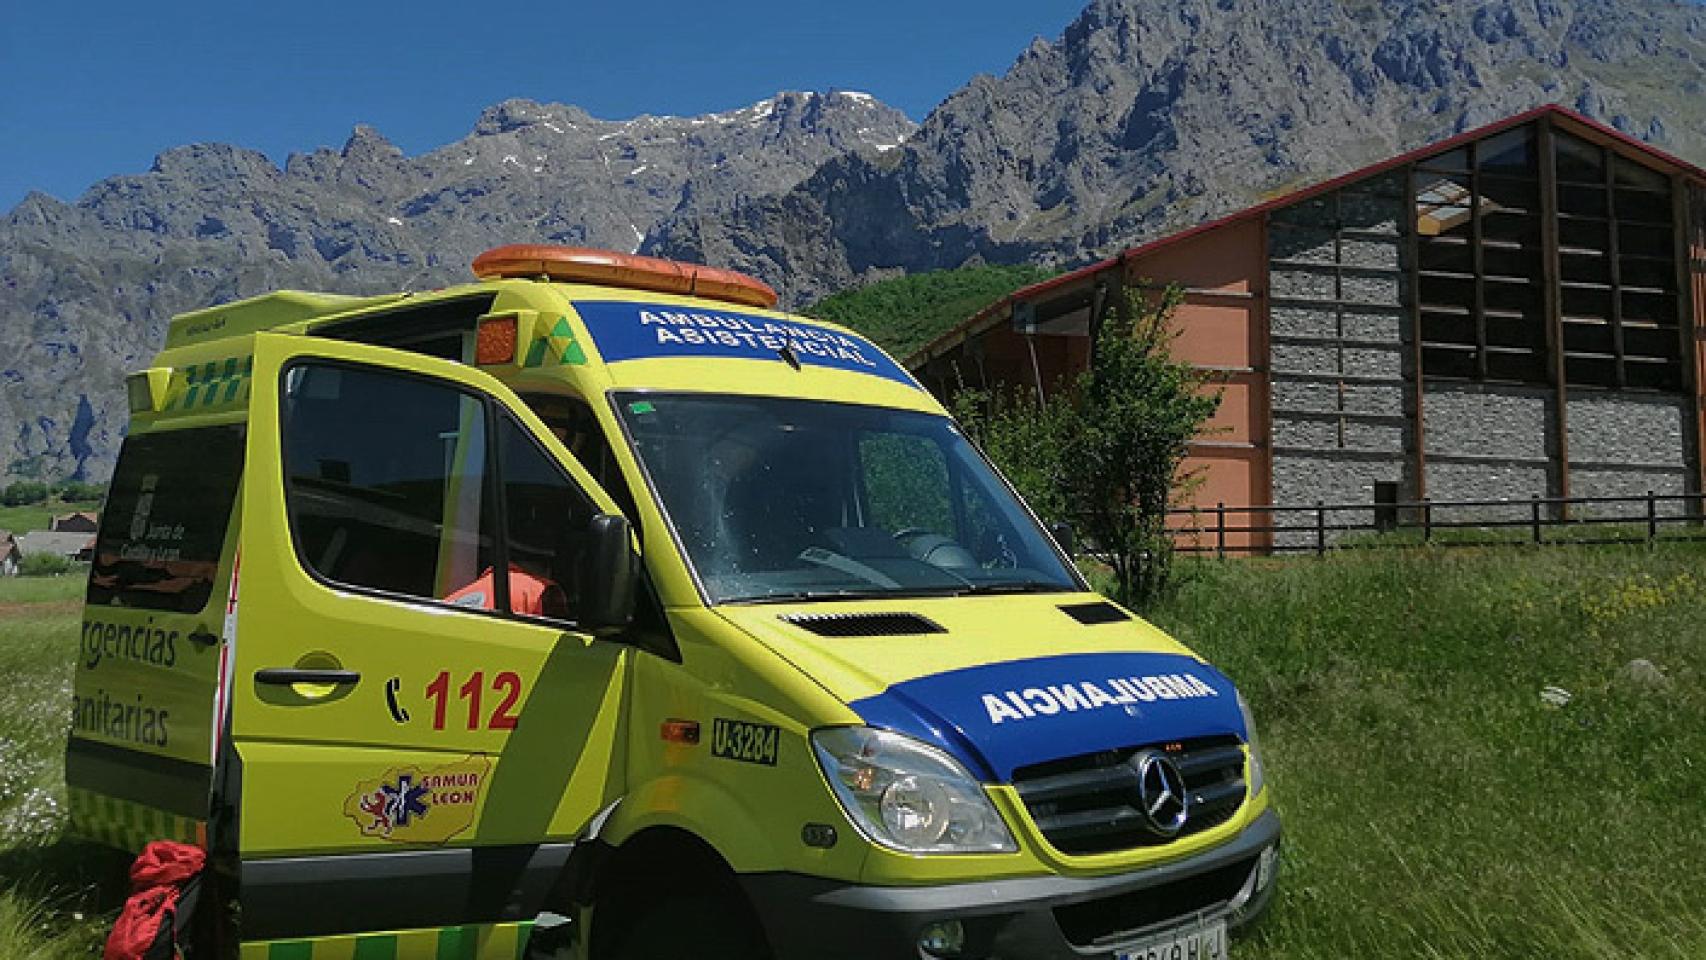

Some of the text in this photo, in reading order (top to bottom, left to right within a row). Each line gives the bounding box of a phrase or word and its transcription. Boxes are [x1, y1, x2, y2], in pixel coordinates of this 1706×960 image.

[640, 311, 861, 350] AMBULANCIA
[657, 328, 876, 367] ASISTENCIAL
[425, 672, 521, 731] 112
[715, 722, 776, 763] U-3284
[422, 774, 478, 787] SAMUR
